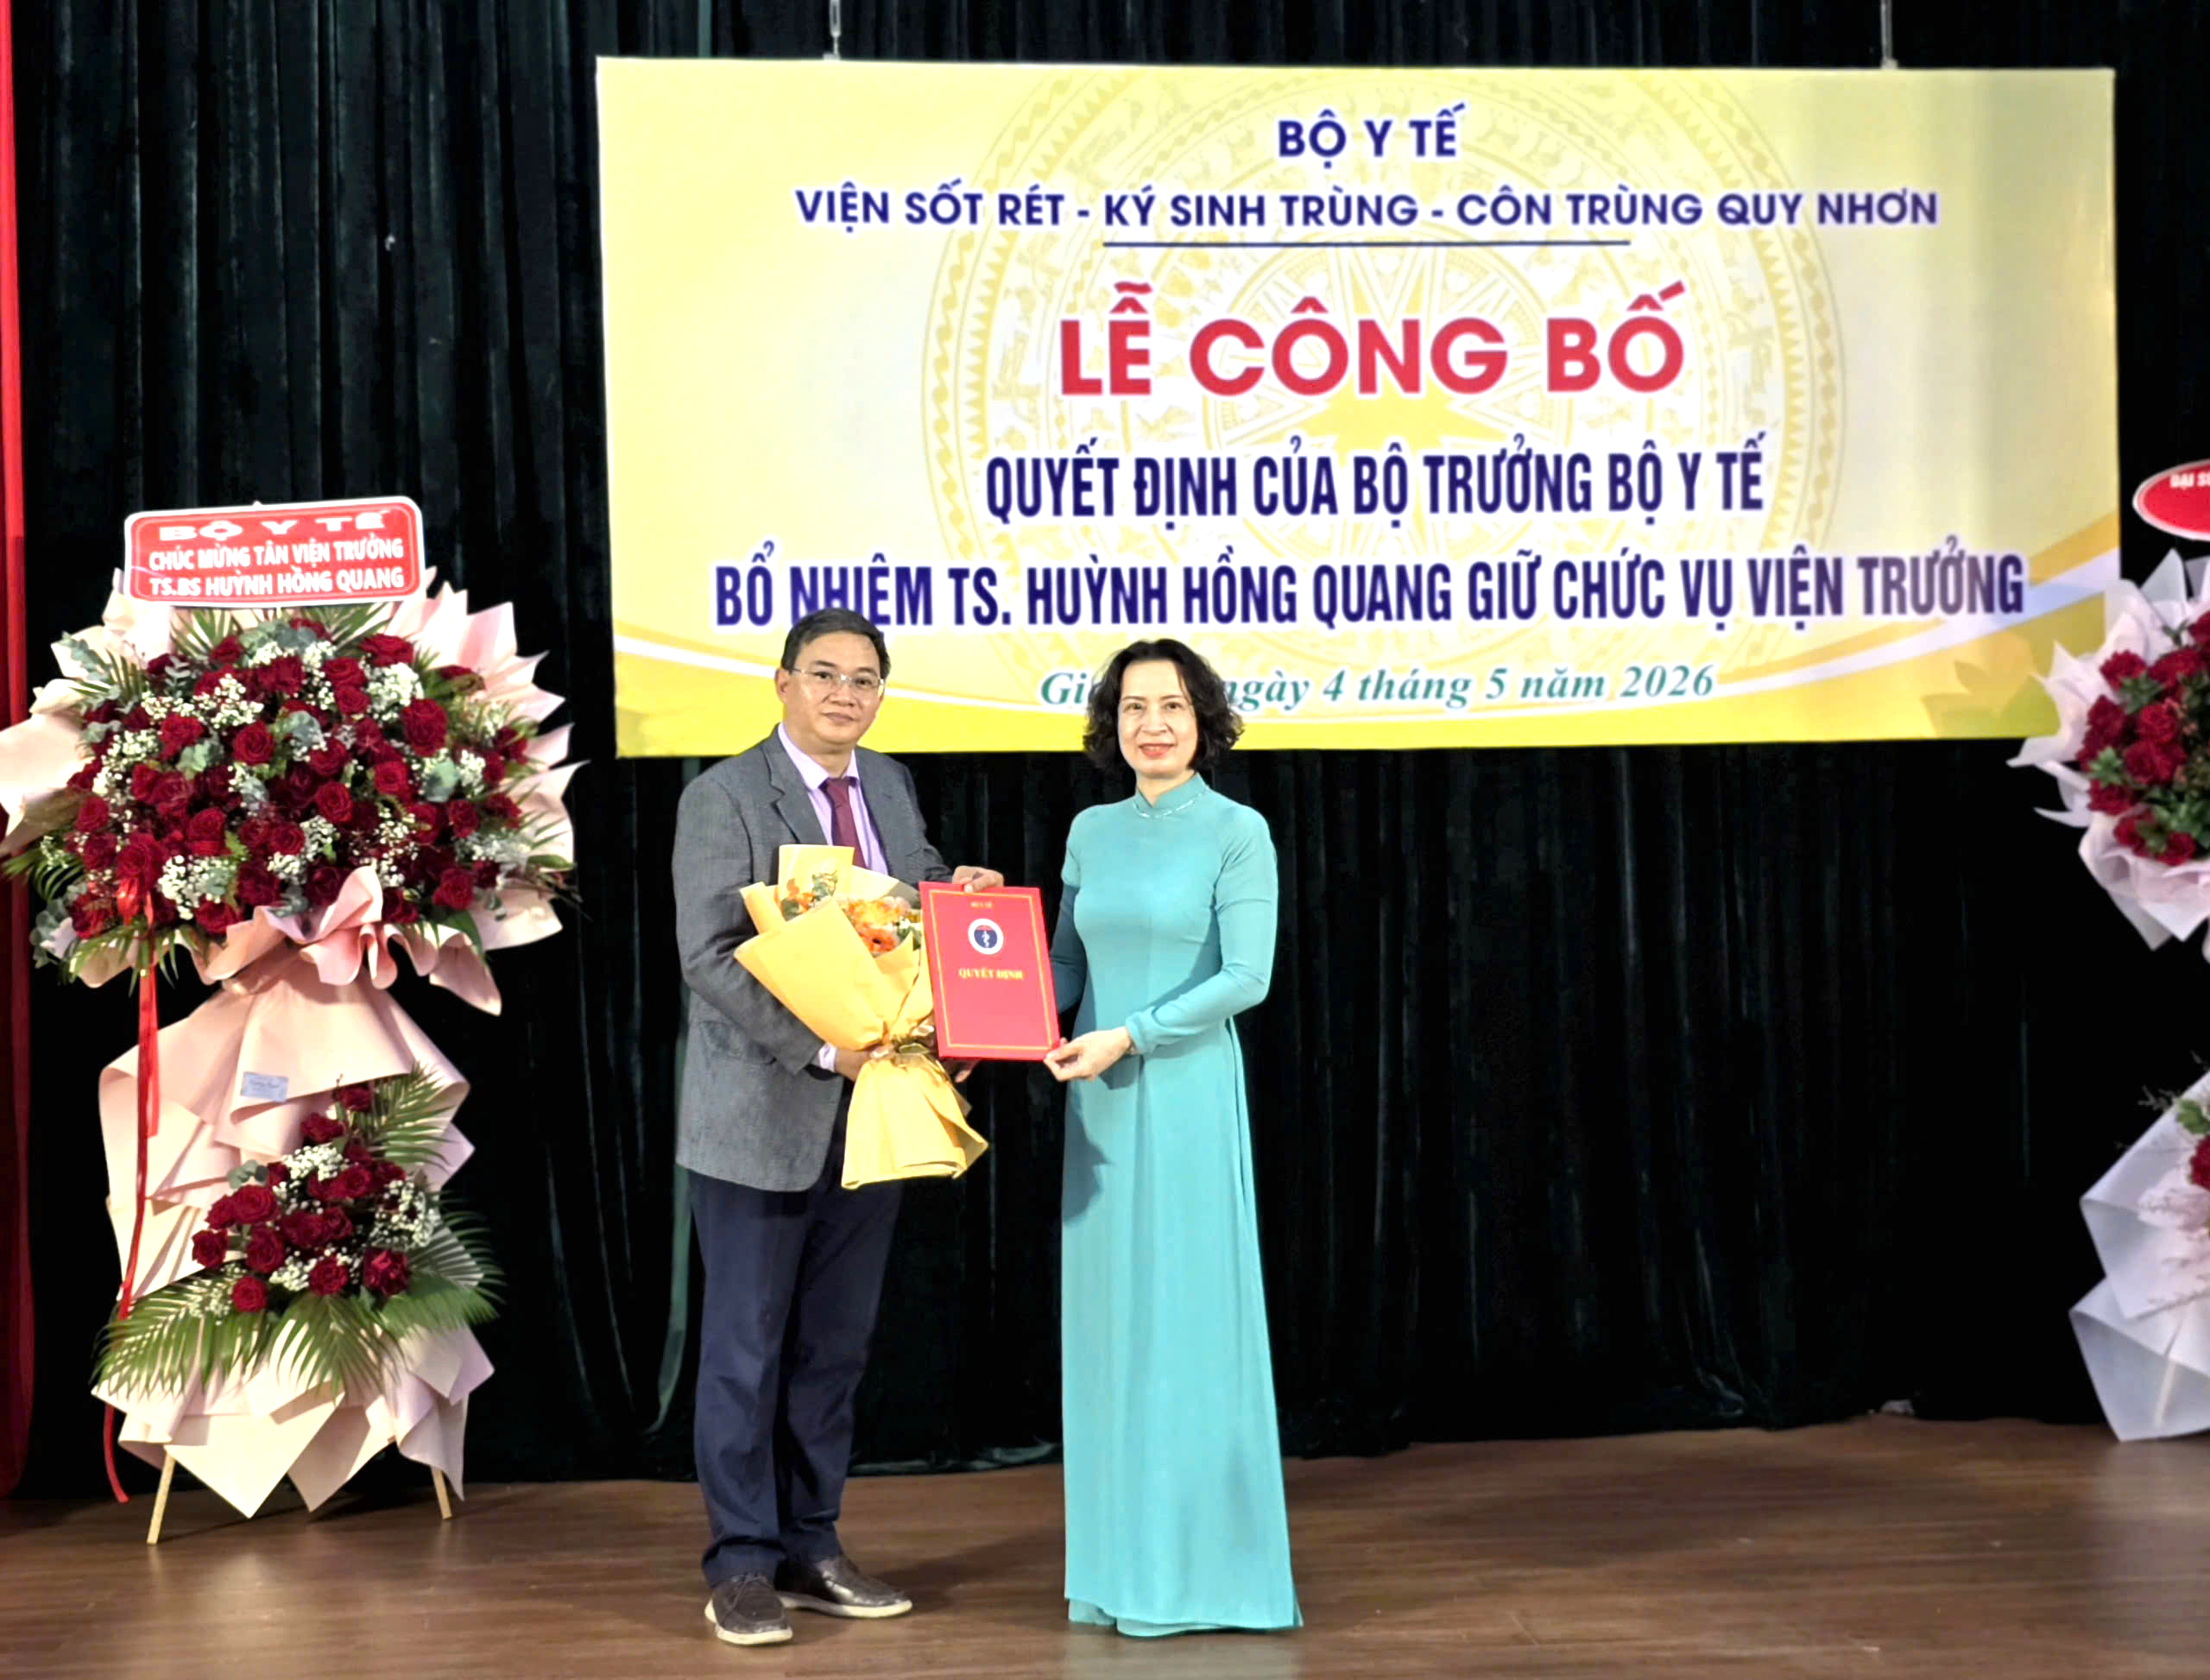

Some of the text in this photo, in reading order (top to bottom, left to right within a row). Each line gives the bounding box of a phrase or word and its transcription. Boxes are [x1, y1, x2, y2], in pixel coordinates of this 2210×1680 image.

[1279, 102, 1466, 168] BỘ Y TẾ
[795, 178, 1937, 233] VIỆN SỐT RÉT - KÝ SINH TRÙNG - CÔN TRÙNG QUY NHƠN
[1061, 280, 1685, 397] LỄ CÔNG BỐ
[987, 431, 1766, 531] QUYẾT ĐỊNH CỦA BỘ TRƯỞNG BỘ Y TẾ
[149, 544, 194, 571] CHÚC
[254, 540, 288, 565] TÂN
[293, 537, 330, 568] VIỆN
[333, 532, 404, 561] TRƯỞNG
[160, 509, 390, 540] BỘ Y TẾ
[205, 569, 273, 596] HUỲNH
[337, 566, 405, 593] QUANG
[716, 540, 775, 627] BỔ
[947, 566, 1012, 627] TS.
[1026, 553, 1168, 626] HUỲNH
[1183, 545, 1298, 624] HỒNG
[1313, 562, 1453, 630] QUANG
[1468, 548, 1543, 622] GIỮ
[1553, 546, 1666, 621] CHỨC
[1680, 558, 1733, 632] VỤ
[1747, 544, 1844, 631] VIỆN
[1857, 534, 2025, 616] TRƯỞNG
[1041, 672, 1089, 705] Gi
[1323, 670, 1346, 702] 4
[1358, 668, 1471, 708] tháng
[1486, 667, 1508, 699] 5
[1520, 666, 1606, 699] năm
[1620, 664, 1714, 698] 2026
